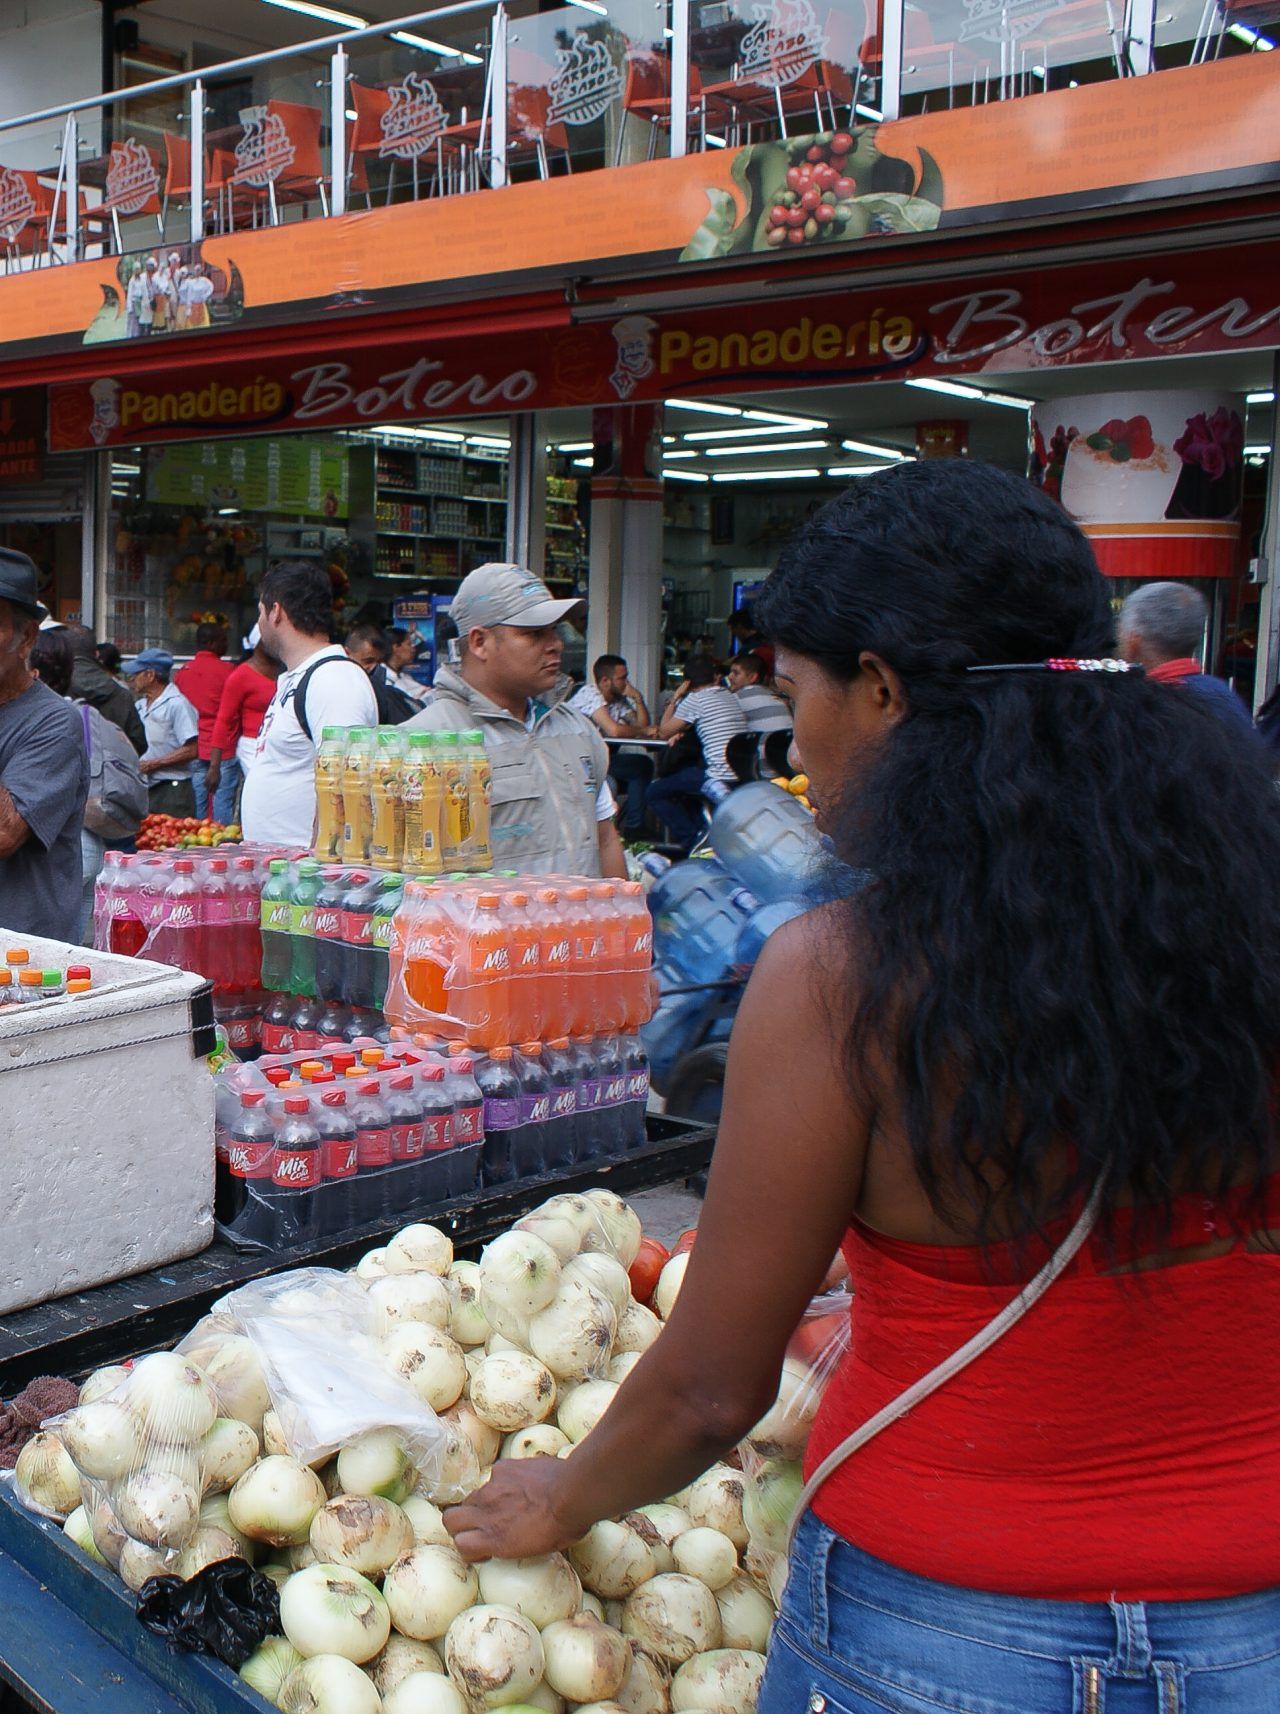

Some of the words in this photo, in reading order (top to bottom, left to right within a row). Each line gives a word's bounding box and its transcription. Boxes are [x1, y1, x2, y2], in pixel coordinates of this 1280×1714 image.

[661, 308, 915, 374] Panadería
[122, 375, 282, 426] Panadería
[290, 356, 538, 420] Botero
[170, 904, 193, 921] Mix
[277, 1156, 308, 1178] Mix
